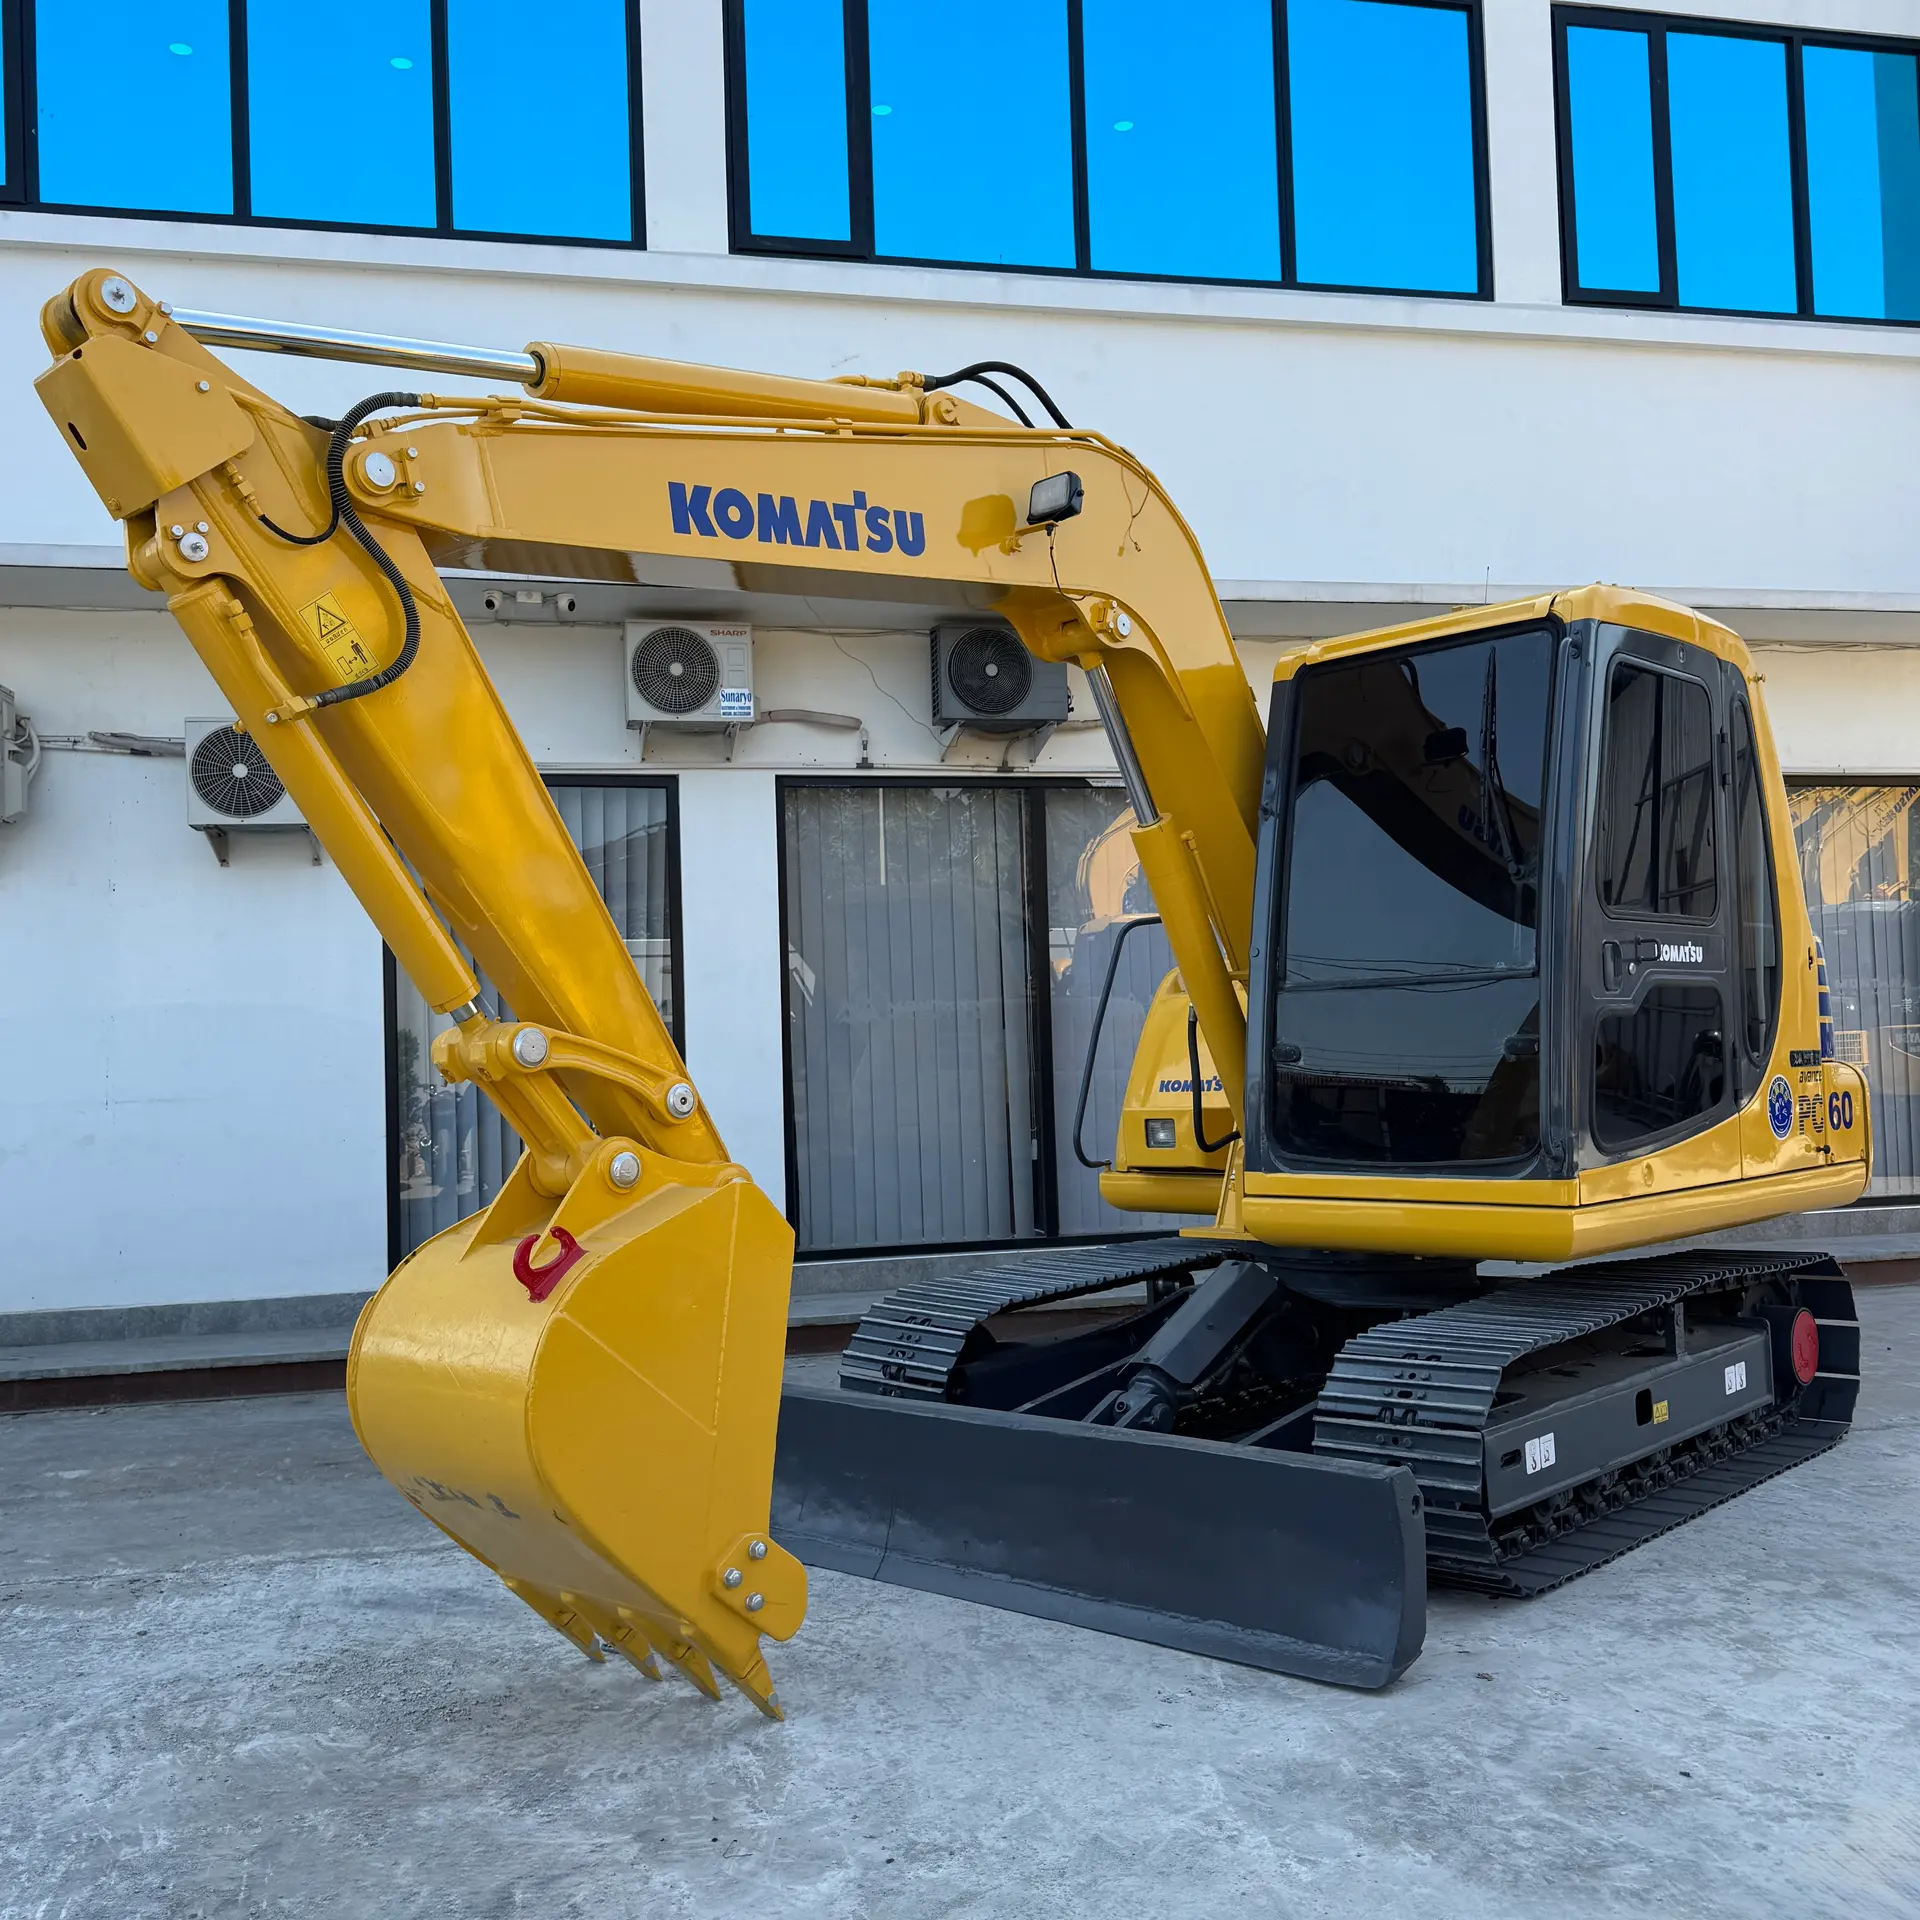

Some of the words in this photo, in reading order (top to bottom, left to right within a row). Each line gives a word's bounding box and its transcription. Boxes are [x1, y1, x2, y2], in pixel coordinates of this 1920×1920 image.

[667, 481, 926, 557] KOMATSU
[710, 629, 747, 637] SHARP
[720, 689, 752, 705] Sunaryo
[1159, 1076, 1223, 1092] KOMTS
[1798, 1093, 1824, 1135] PC
[1828, 1090, 1853, 1131] 60
